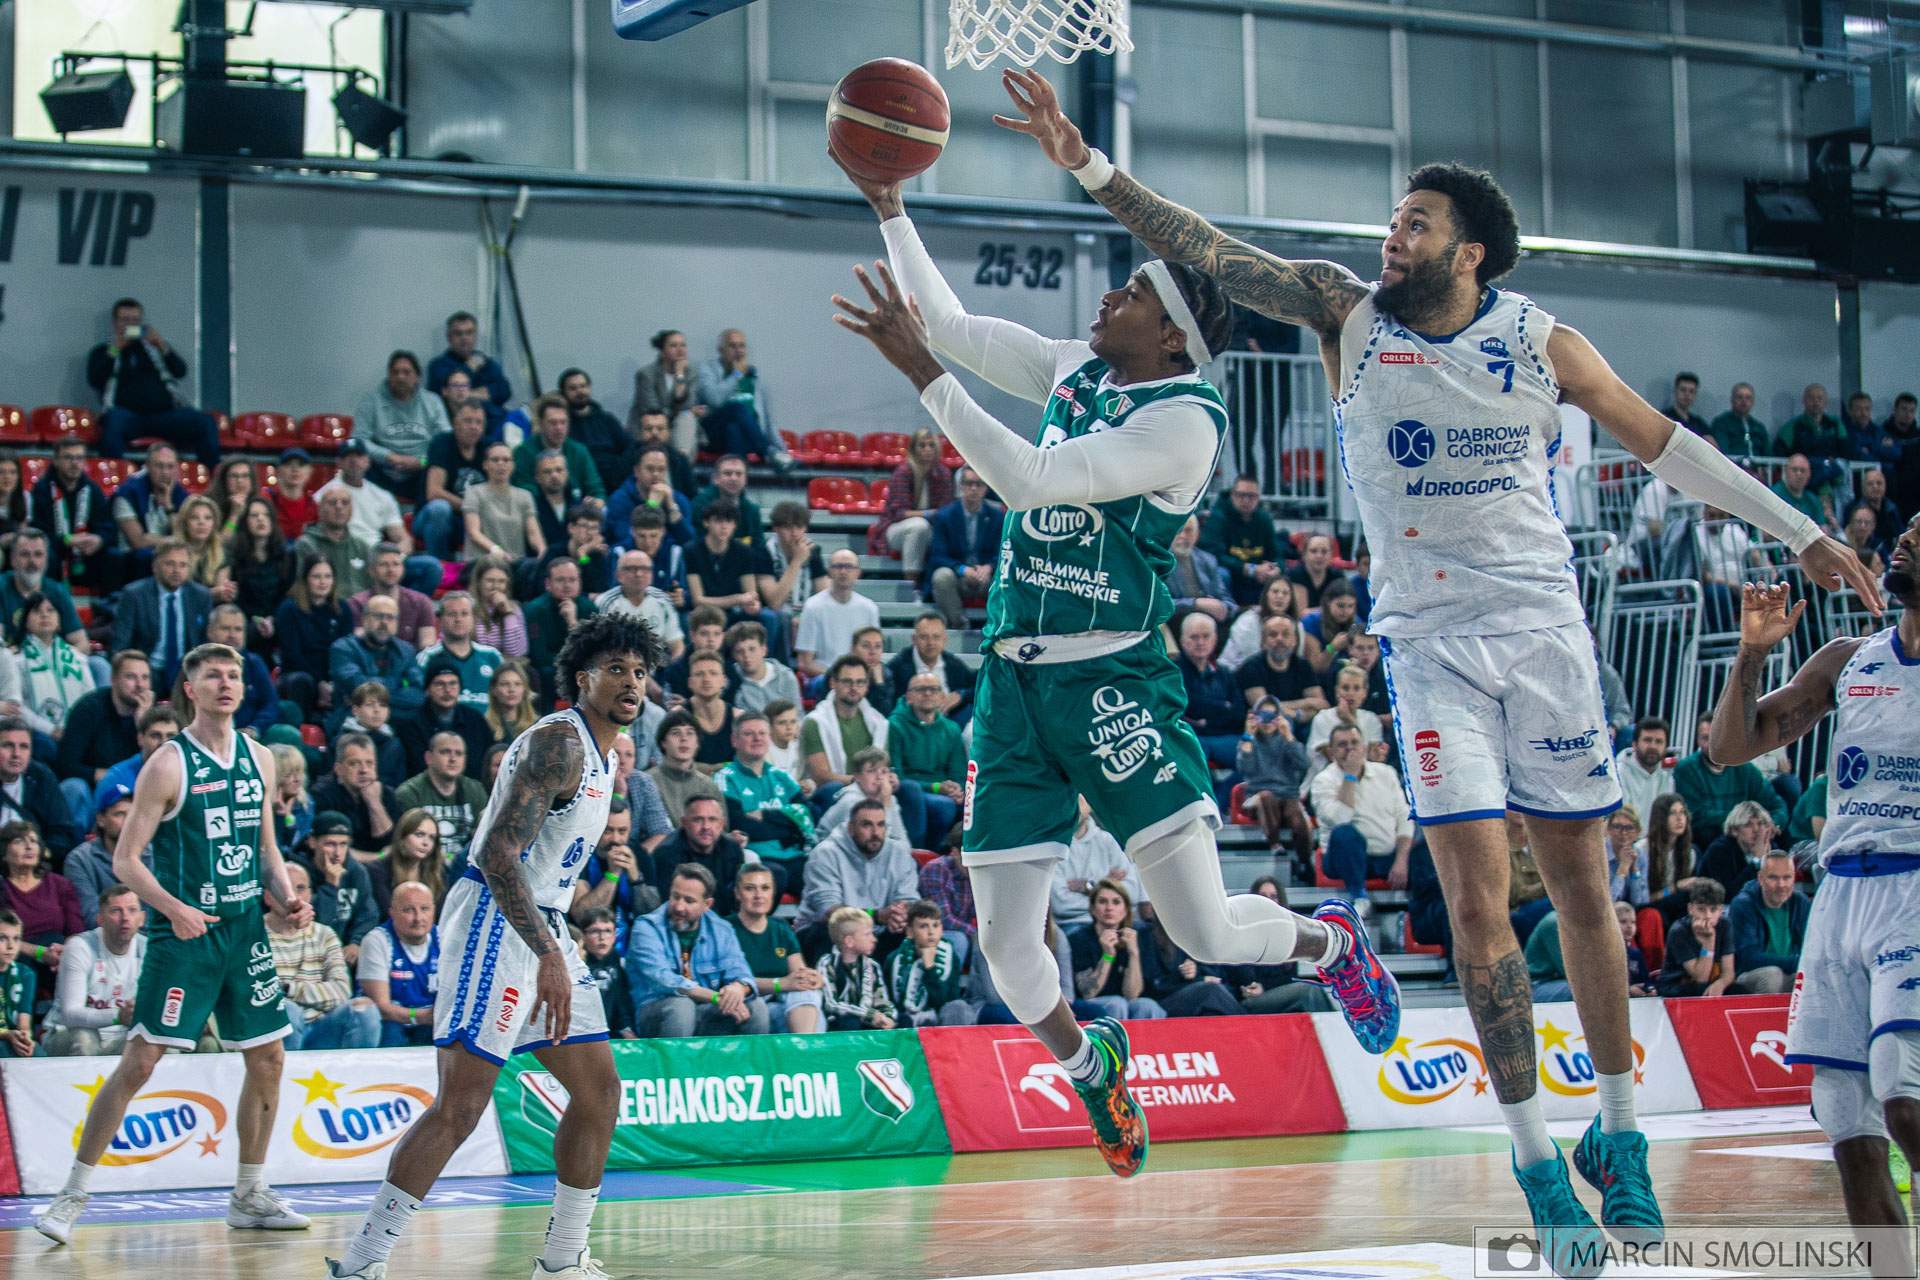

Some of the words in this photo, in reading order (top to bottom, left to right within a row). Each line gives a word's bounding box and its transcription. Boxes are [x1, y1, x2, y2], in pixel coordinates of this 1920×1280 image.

[58, 187, 155, 267] VIP
[975, 242, 1063, 289] 25-32
[1382, 354, 1412, 362] ORLEN
[1482, 341, 1503, 349] MKS
[1487, 361, 1515, 393] 7
[1424, 475, 1520, 496] DROGOPOL
[1039, 506, 1086, 533] LOTTO
[1016, 567, 1120, 604] WARSZAWSKIE
[1029, 556, 1109, 586] TRAMWAJE
[1088, 708, 1153, 745] UNIQA
[1109, 736, 1150, 772] LOTTO
[235, 779, 263, 803] 23
[247, 960, 274, 976] UNIQ
[1396, 1051, 1467, 1091] LOTTO
[616, 1072, 842, 1126] EGIAKOSZ.COM
[318, 1097, 411, 1142] LOTTO
